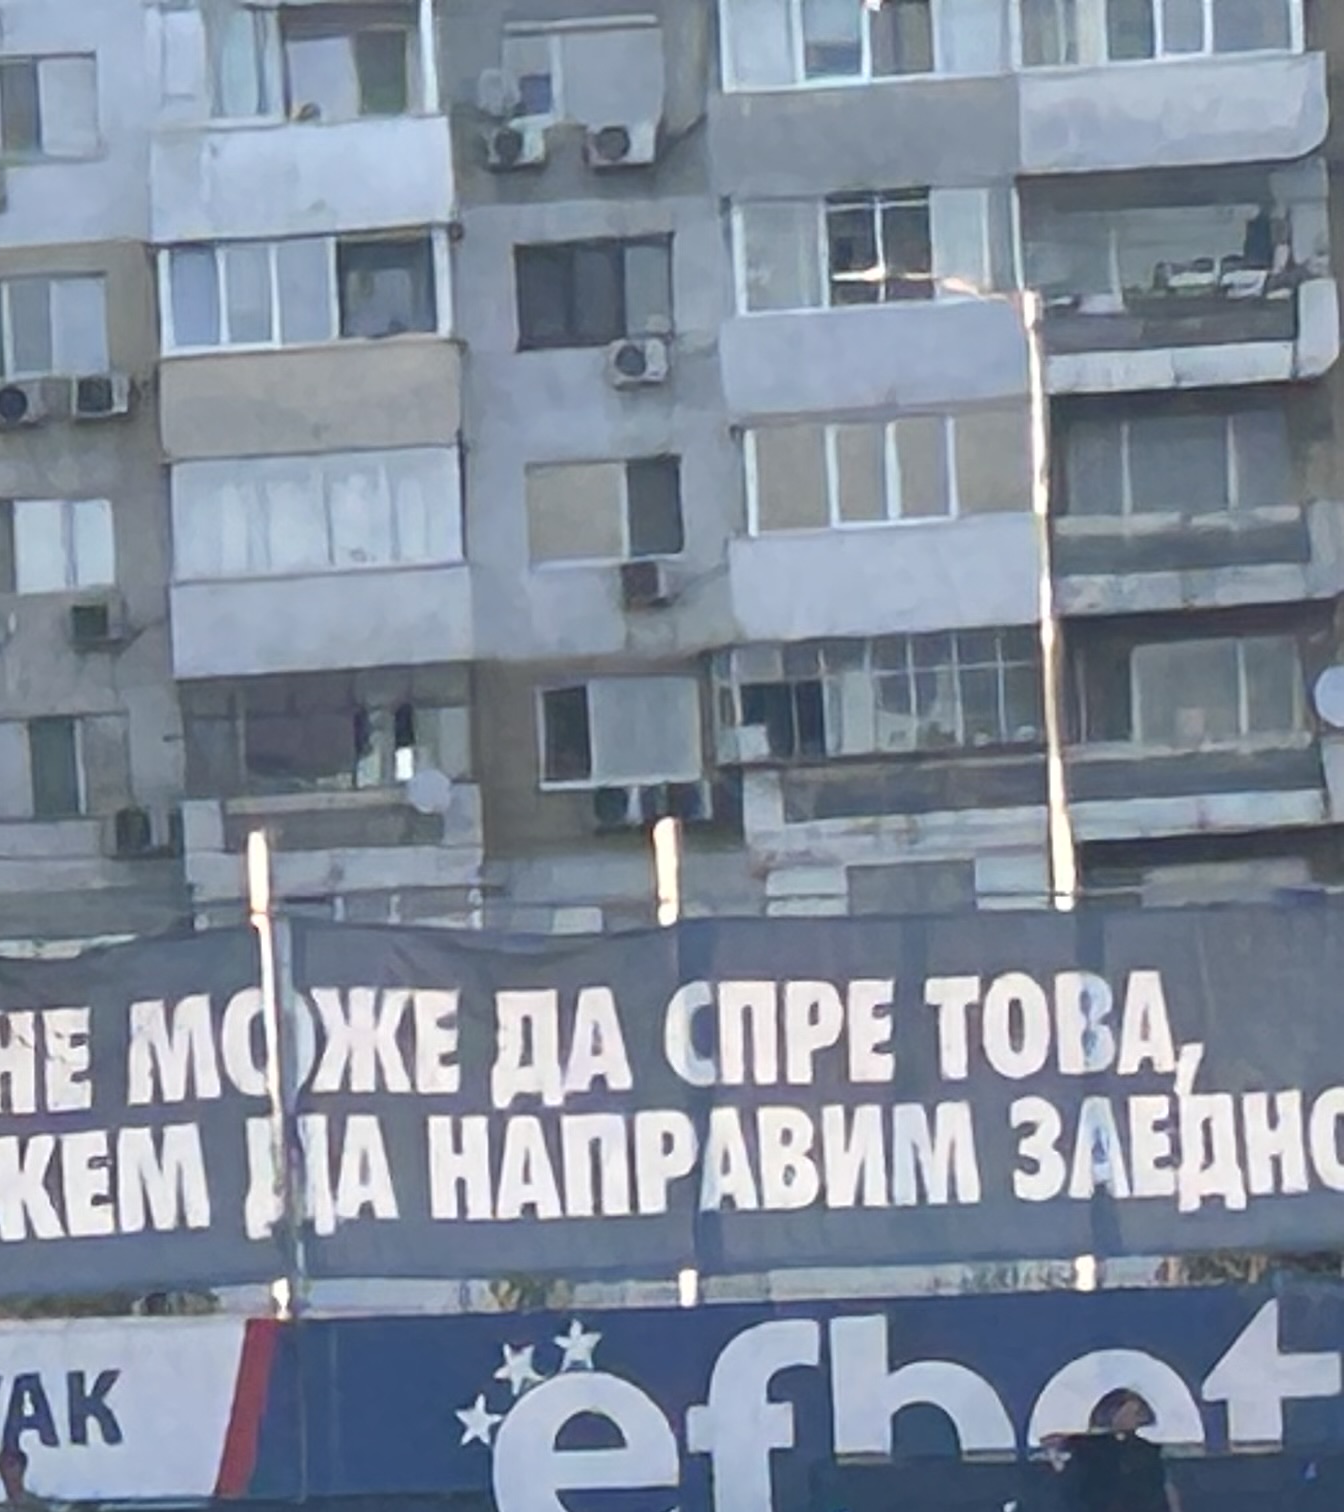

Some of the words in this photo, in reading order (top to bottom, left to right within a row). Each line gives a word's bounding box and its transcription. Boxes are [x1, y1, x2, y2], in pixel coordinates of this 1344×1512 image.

[128, 988, 459, 1106] МОЖЕ
[492, 986, 633, 1110] ДА
[663, 977, 897, 1089] СПРЕ
[924, 968, 1206, 1100] ТОВА,
[427, 1099, 980, 1222] НАПРАВИМ
